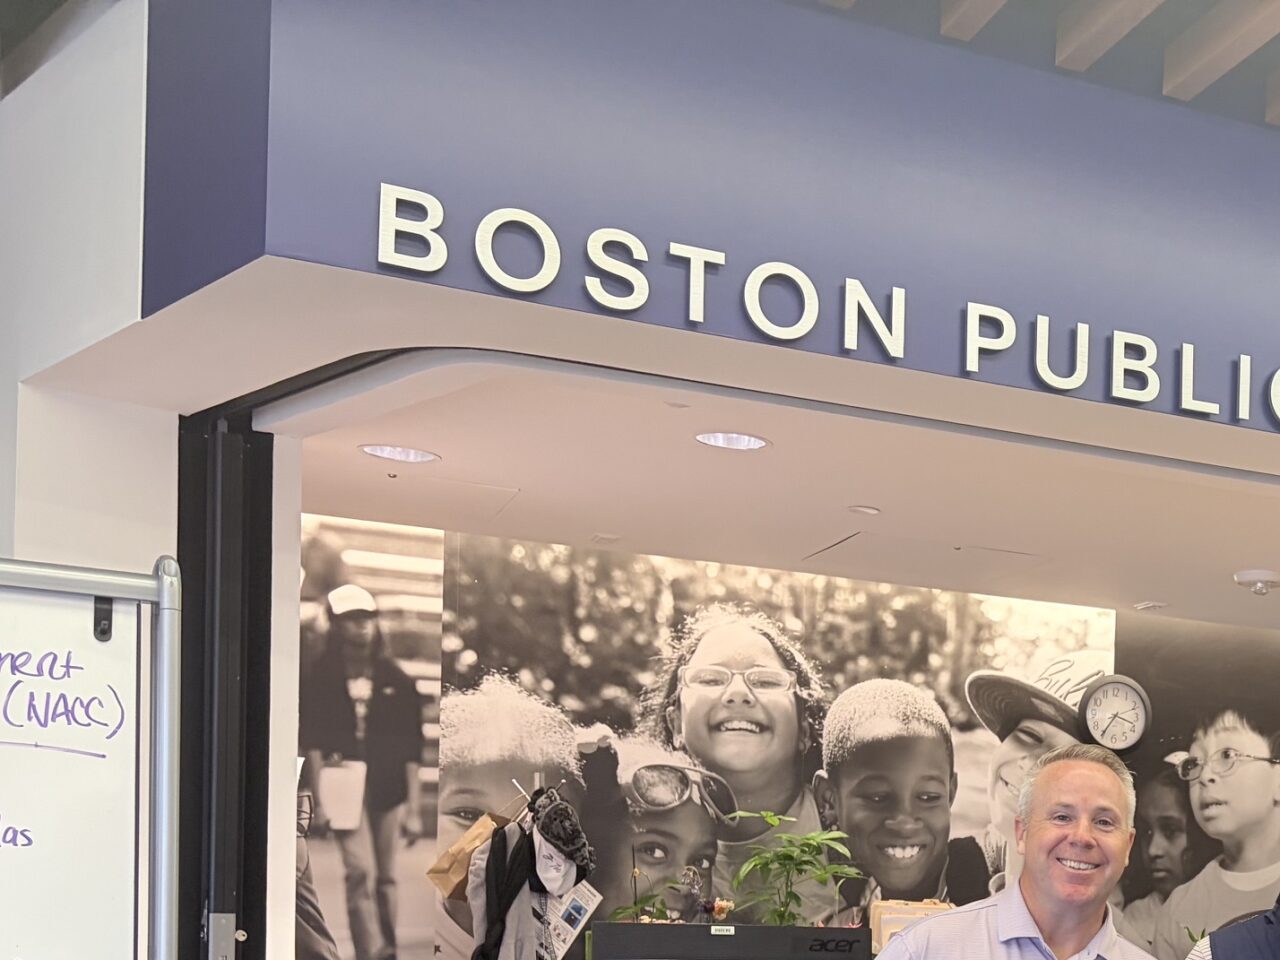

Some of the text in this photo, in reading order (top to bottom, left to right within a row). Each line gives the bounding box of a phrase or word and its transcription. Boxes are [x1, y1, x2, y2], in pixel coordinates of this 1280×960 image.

[376, 182, 906, 360] BOSTON
[2, 680, 125, 740] (NACC)
[1112, 688, 1120, 698] 12
[808, 938, 860, 953] acer
